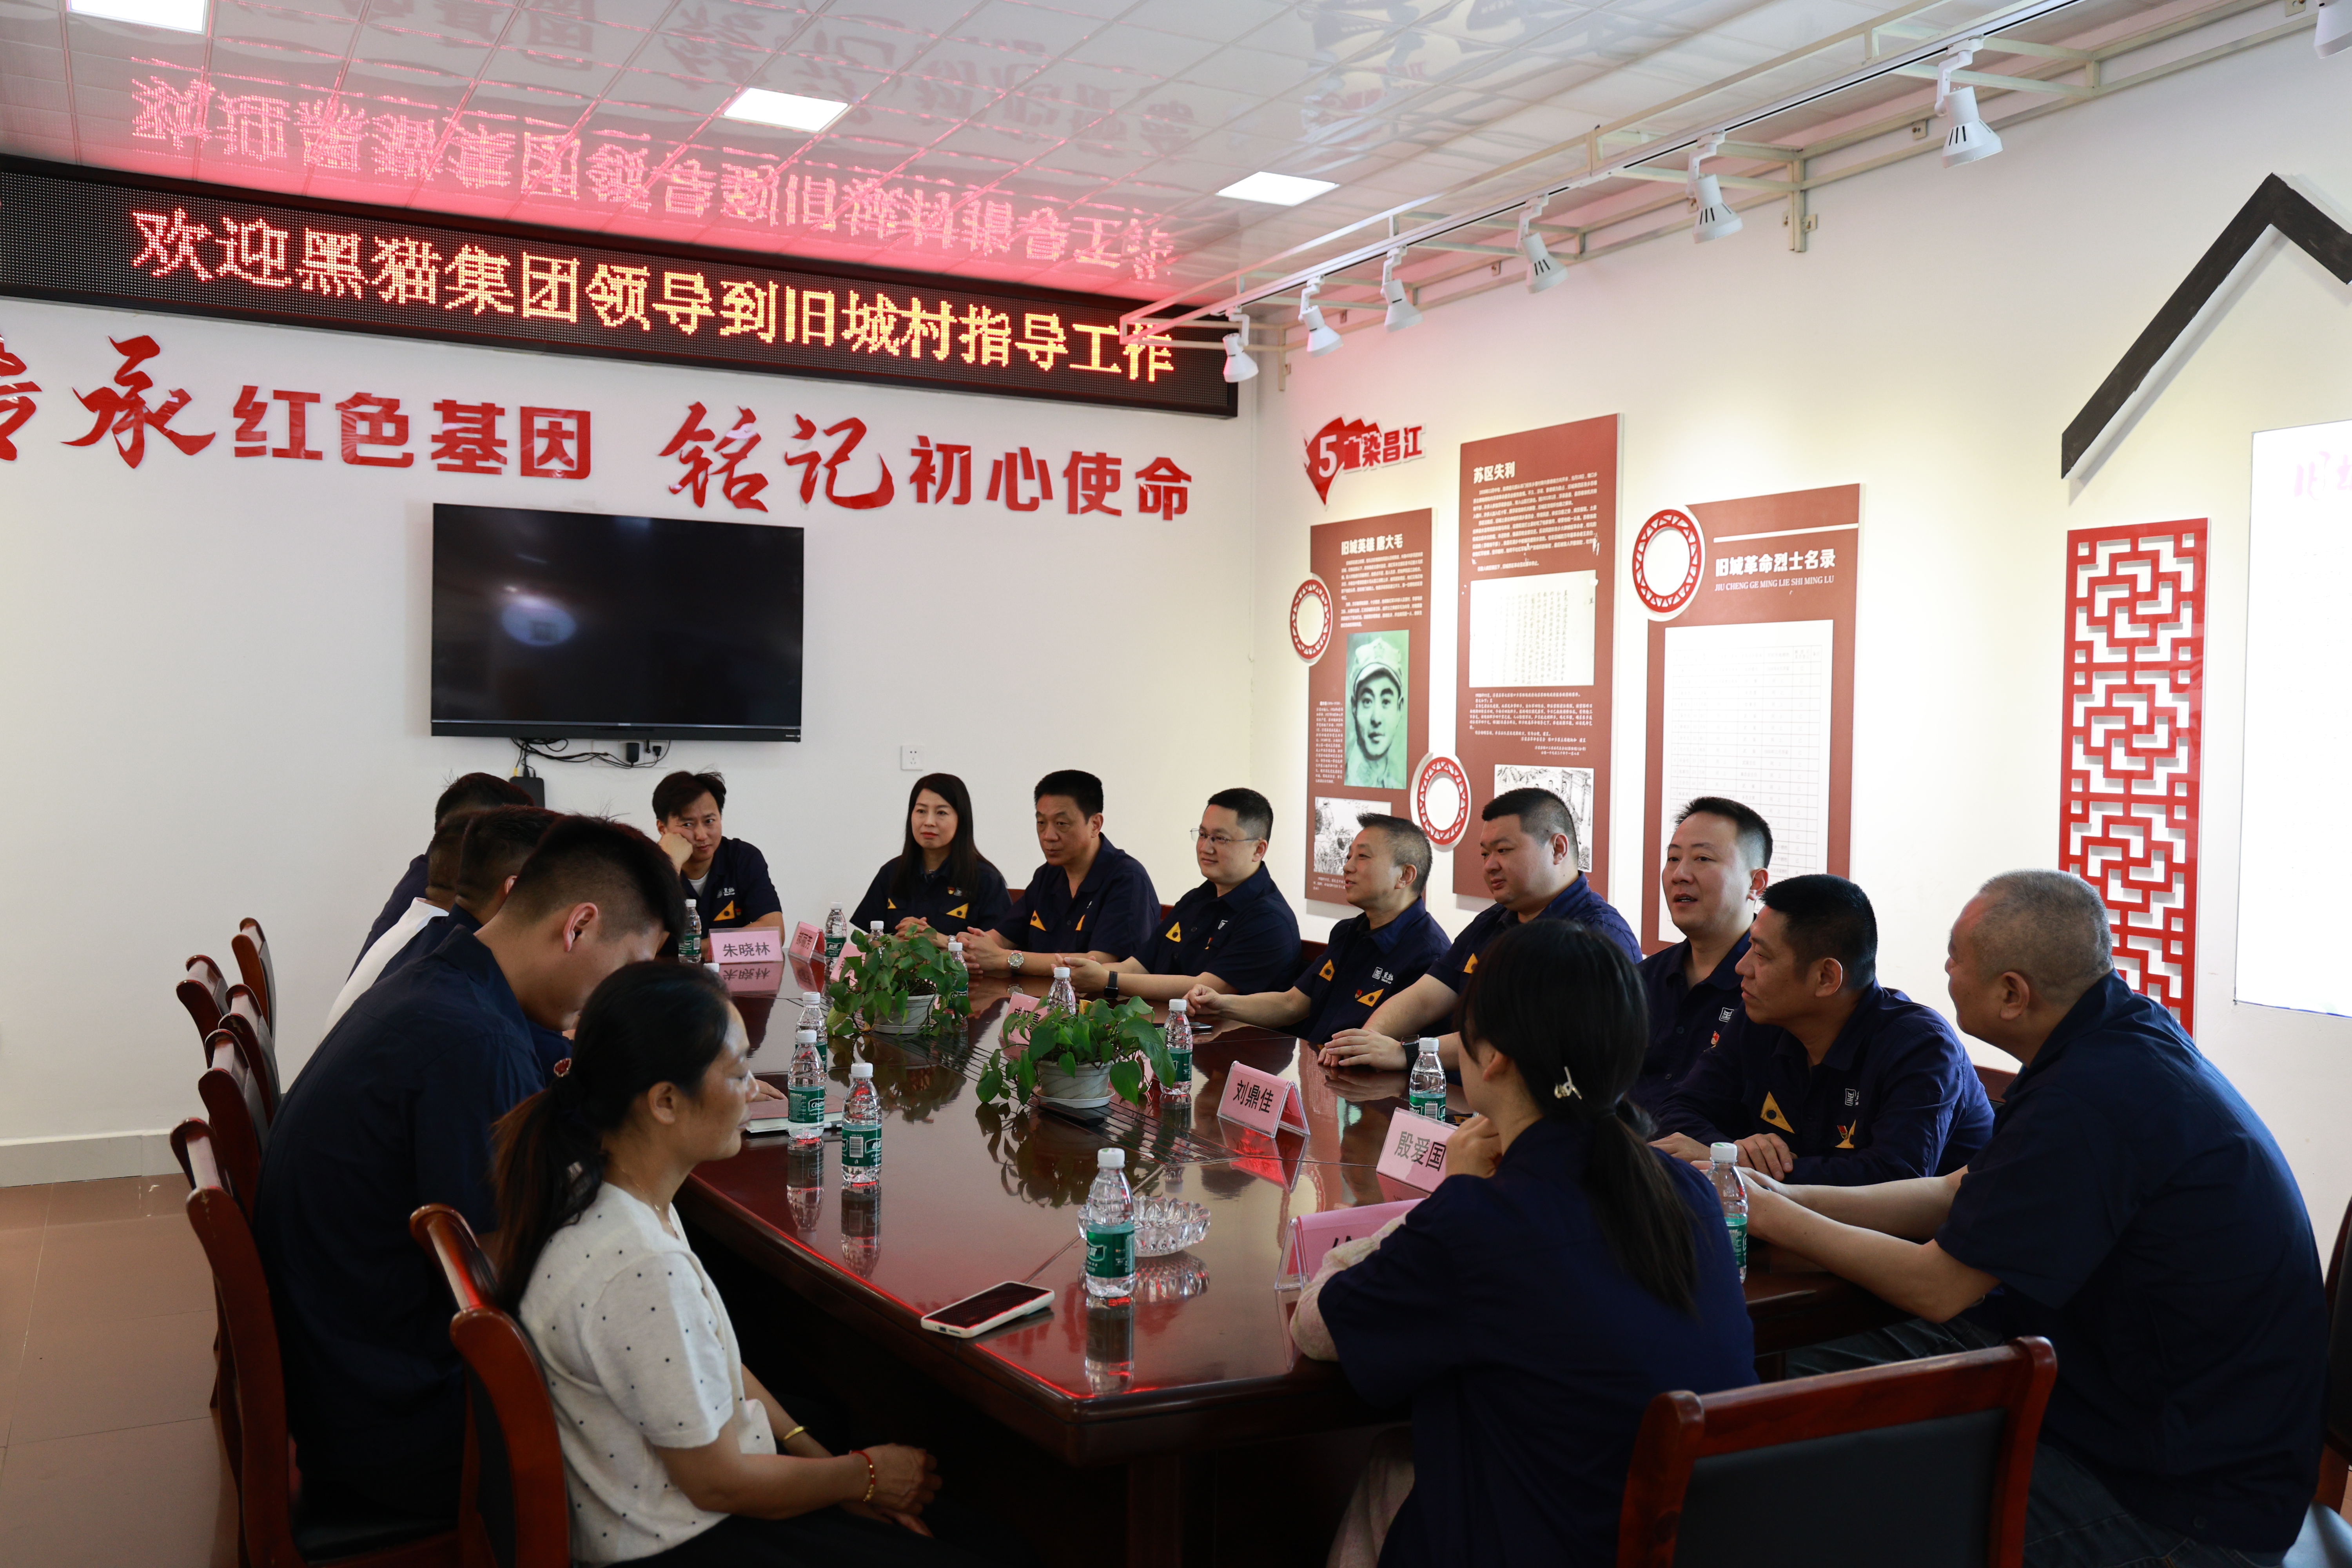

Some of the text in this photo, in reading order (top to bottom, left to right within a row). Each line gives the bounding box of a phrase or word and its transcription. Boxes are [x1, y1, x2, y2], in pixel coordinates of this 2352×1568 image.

[132, 208, 1174, 382] 欢迎黑猫集团领导到旧城村指导工作
[659, 401, 1192, 521] 铭记初心使命
[1319, 434, 1338, 477] 5
[1474, 461, 1515, 484] 苏区失利
[1341, 534, 1403, 555] 旧城英雄 唐大毛
[1715, 548, 1836, 577] 旧城革命烈士名录
[1726, 581, 1748, 590] CHENG
[1760, 580, 1777, 588] MING
[1779, 579, 1790, 587] LIE
[1791, 577, 1803, 586] SHI
[1804, 576, 1823, 584] MING
[1824, 575, 1835, 584] LU
[723, 942, 770, 957] 朱晓林
[1233, 1079, 1274, 1114] 刘鼎佳
[1394, 1131, 1446, 1172] 殷爱国
